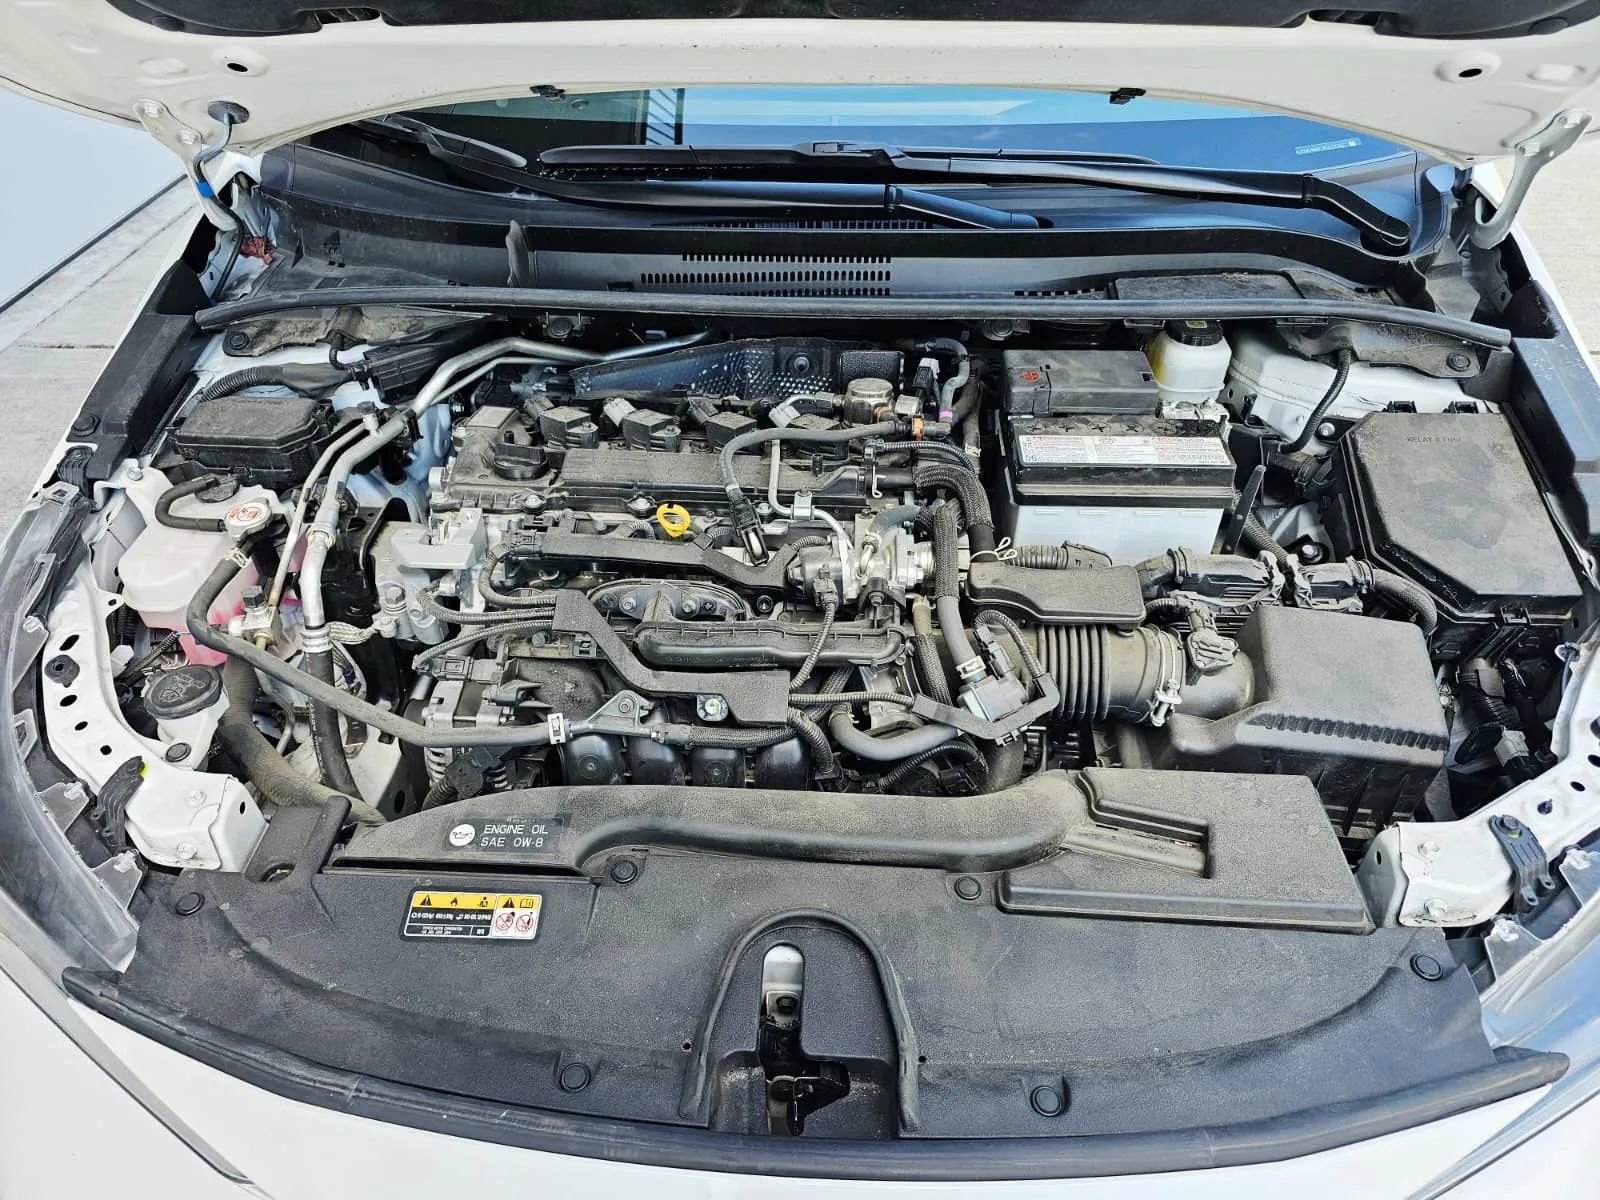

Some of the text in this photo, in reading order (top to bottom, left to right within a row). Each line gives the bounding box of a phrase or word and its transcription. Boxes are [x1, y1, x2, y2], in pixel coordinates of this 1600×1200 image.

[483, 824, 549, 835] ENGINE OIL
[480, 837, 544, 848] SAE 0W-8
